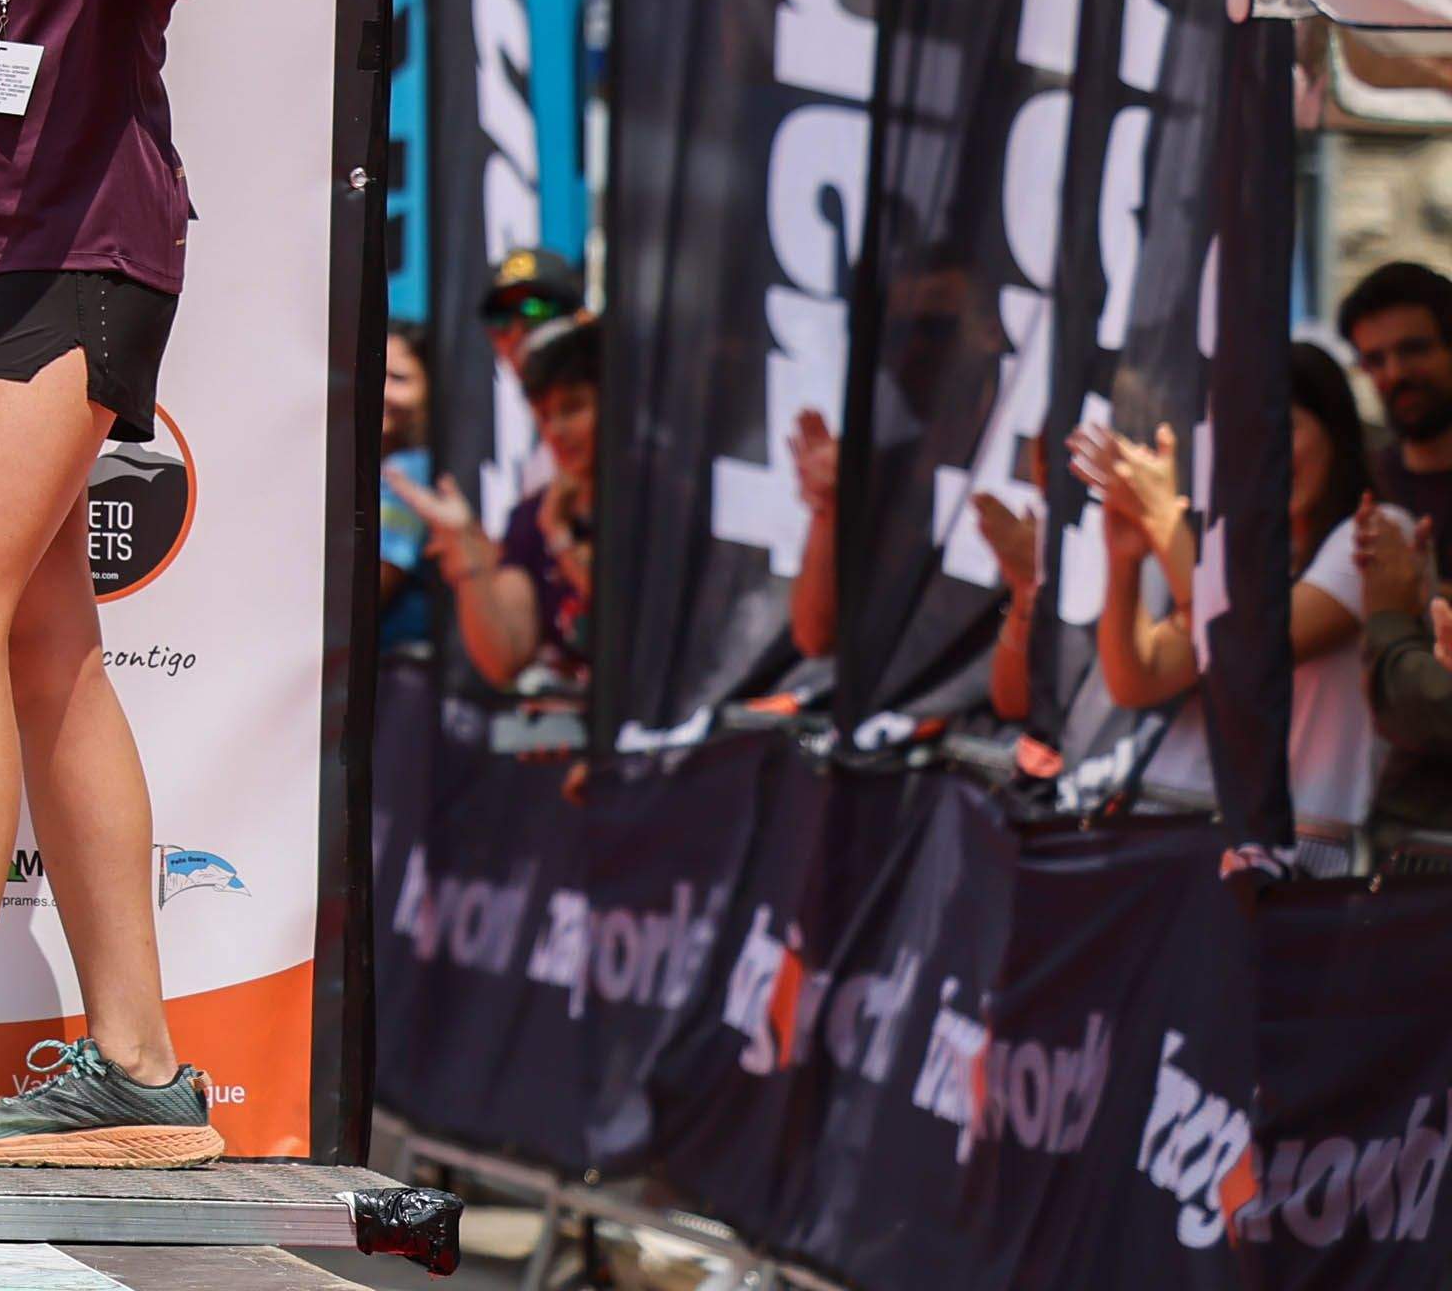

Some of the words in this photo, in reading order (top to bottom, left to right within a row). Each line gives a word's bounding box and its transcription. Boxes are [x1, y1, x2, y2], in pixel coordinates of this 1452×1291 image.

[88, 500, 135, 530] ETO
[88, 532, 134, 562] ETS
[101, 645, 197, 678] contigo
